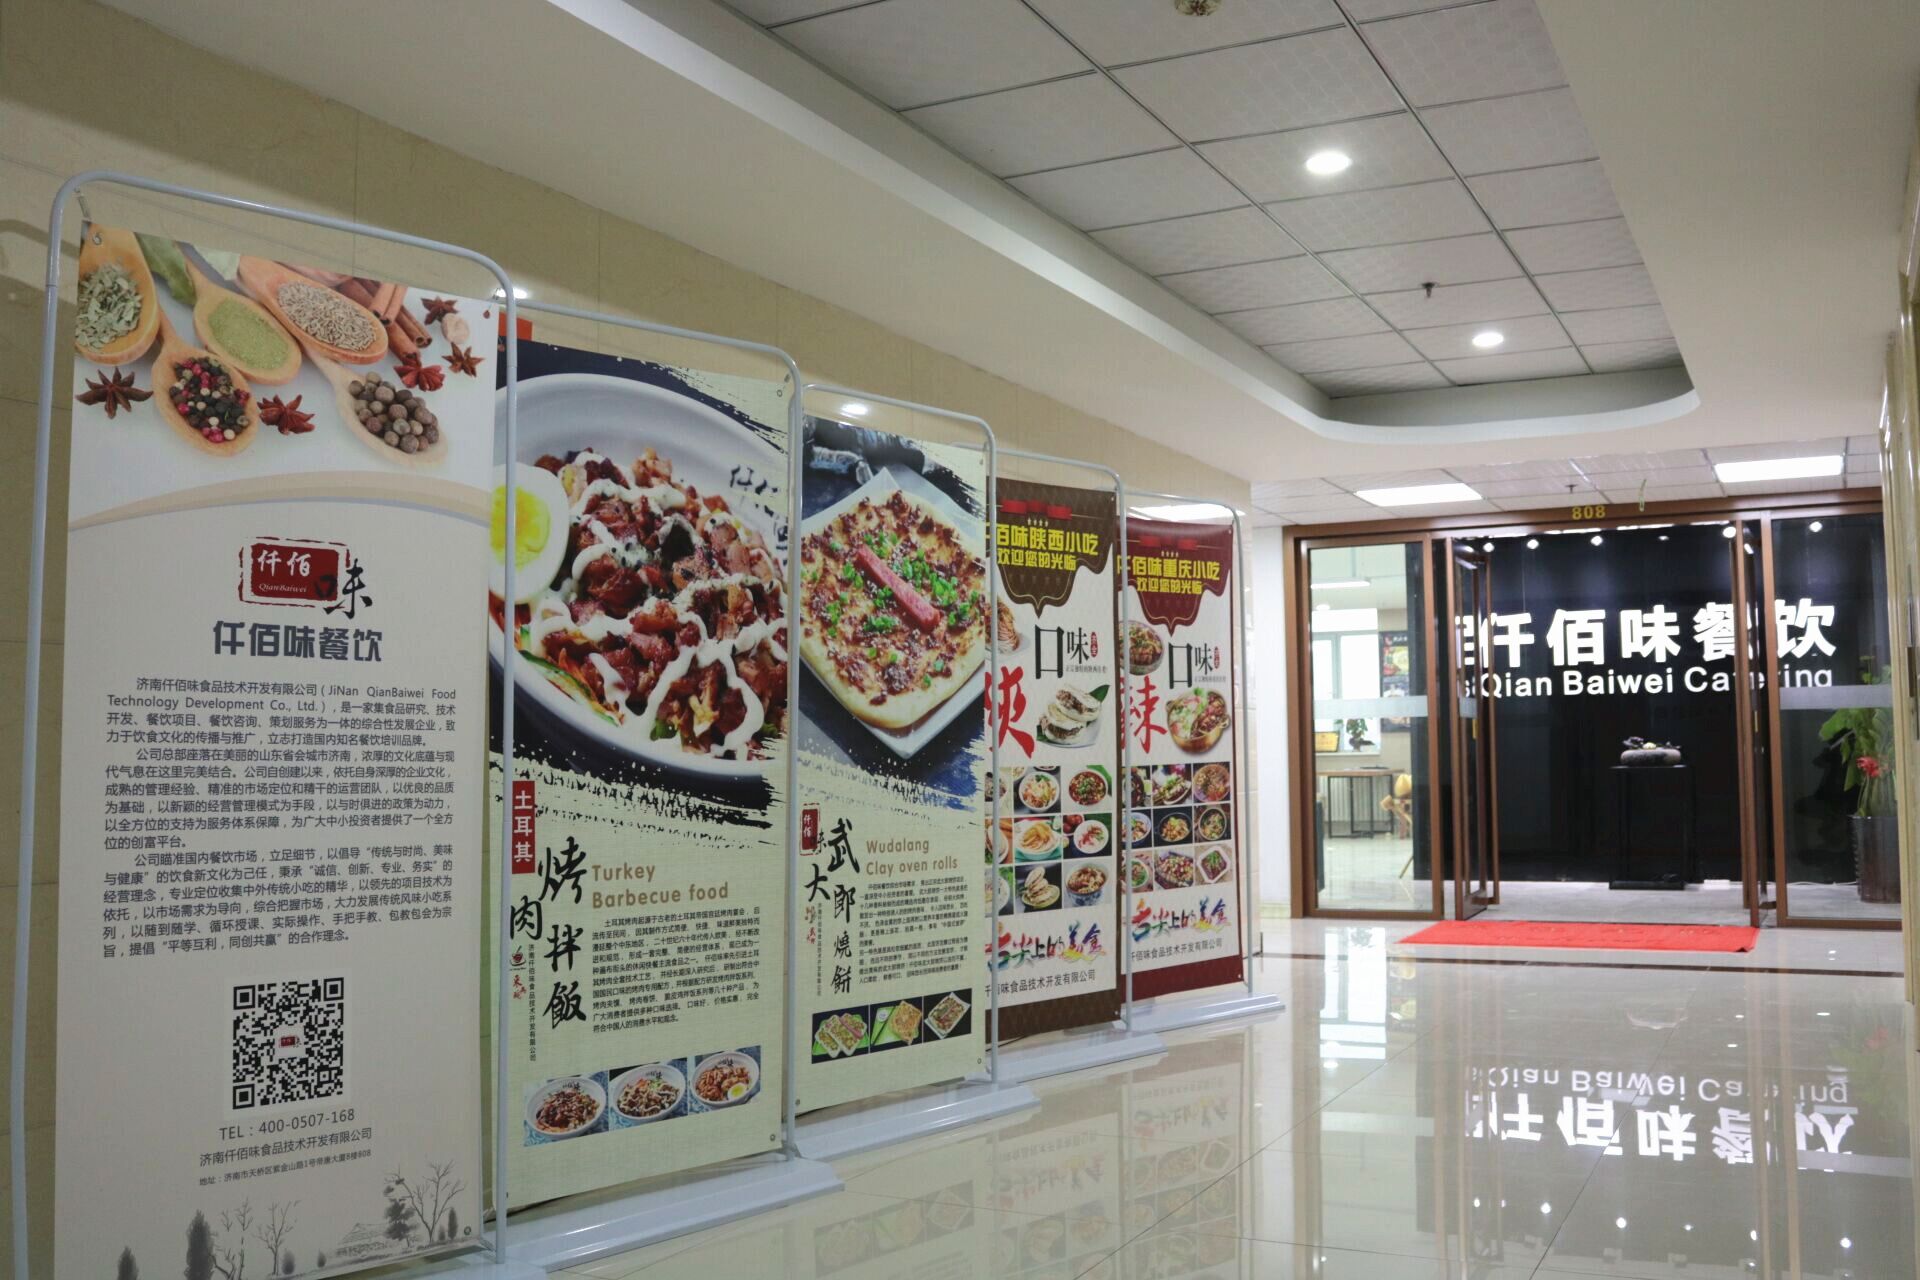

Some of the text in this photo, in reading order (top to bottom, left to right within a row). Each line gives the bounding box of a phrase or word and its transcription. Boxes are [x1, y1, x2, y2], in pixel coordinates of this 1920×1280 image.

[1571, 505, 1606, 520] 808
[997, 548, 1077, 571] 欢迎您的光临
[1136, 577, 1202, 594] 欢迎您的光临
[212, 620, 383, 663] 仟佰味餐饮
[1478, 598, 1837, 669] 仟佰味餐饮
[366, 686, 425, 699] QianBaiwei
[432, 688, 456, 700] Food
[1480, 671, 1553, 699] Qian
[1563, 666, 1673, 697] Baiwei
[108, 694, 179, 711] Technology
[185, 697, 264, 714] Development
[513, 790, 533, 863] 土耳其
[866, 838, 929, 854] Wudalang
[592, 862, 656, 883] Turkey
[866, 855, 958, 878] Clay oven rolls
[592, 881, 729, 909] Barbecue food
[199, 1127, 372, 1167] 济南仟佰味食品技术开发有限公司
